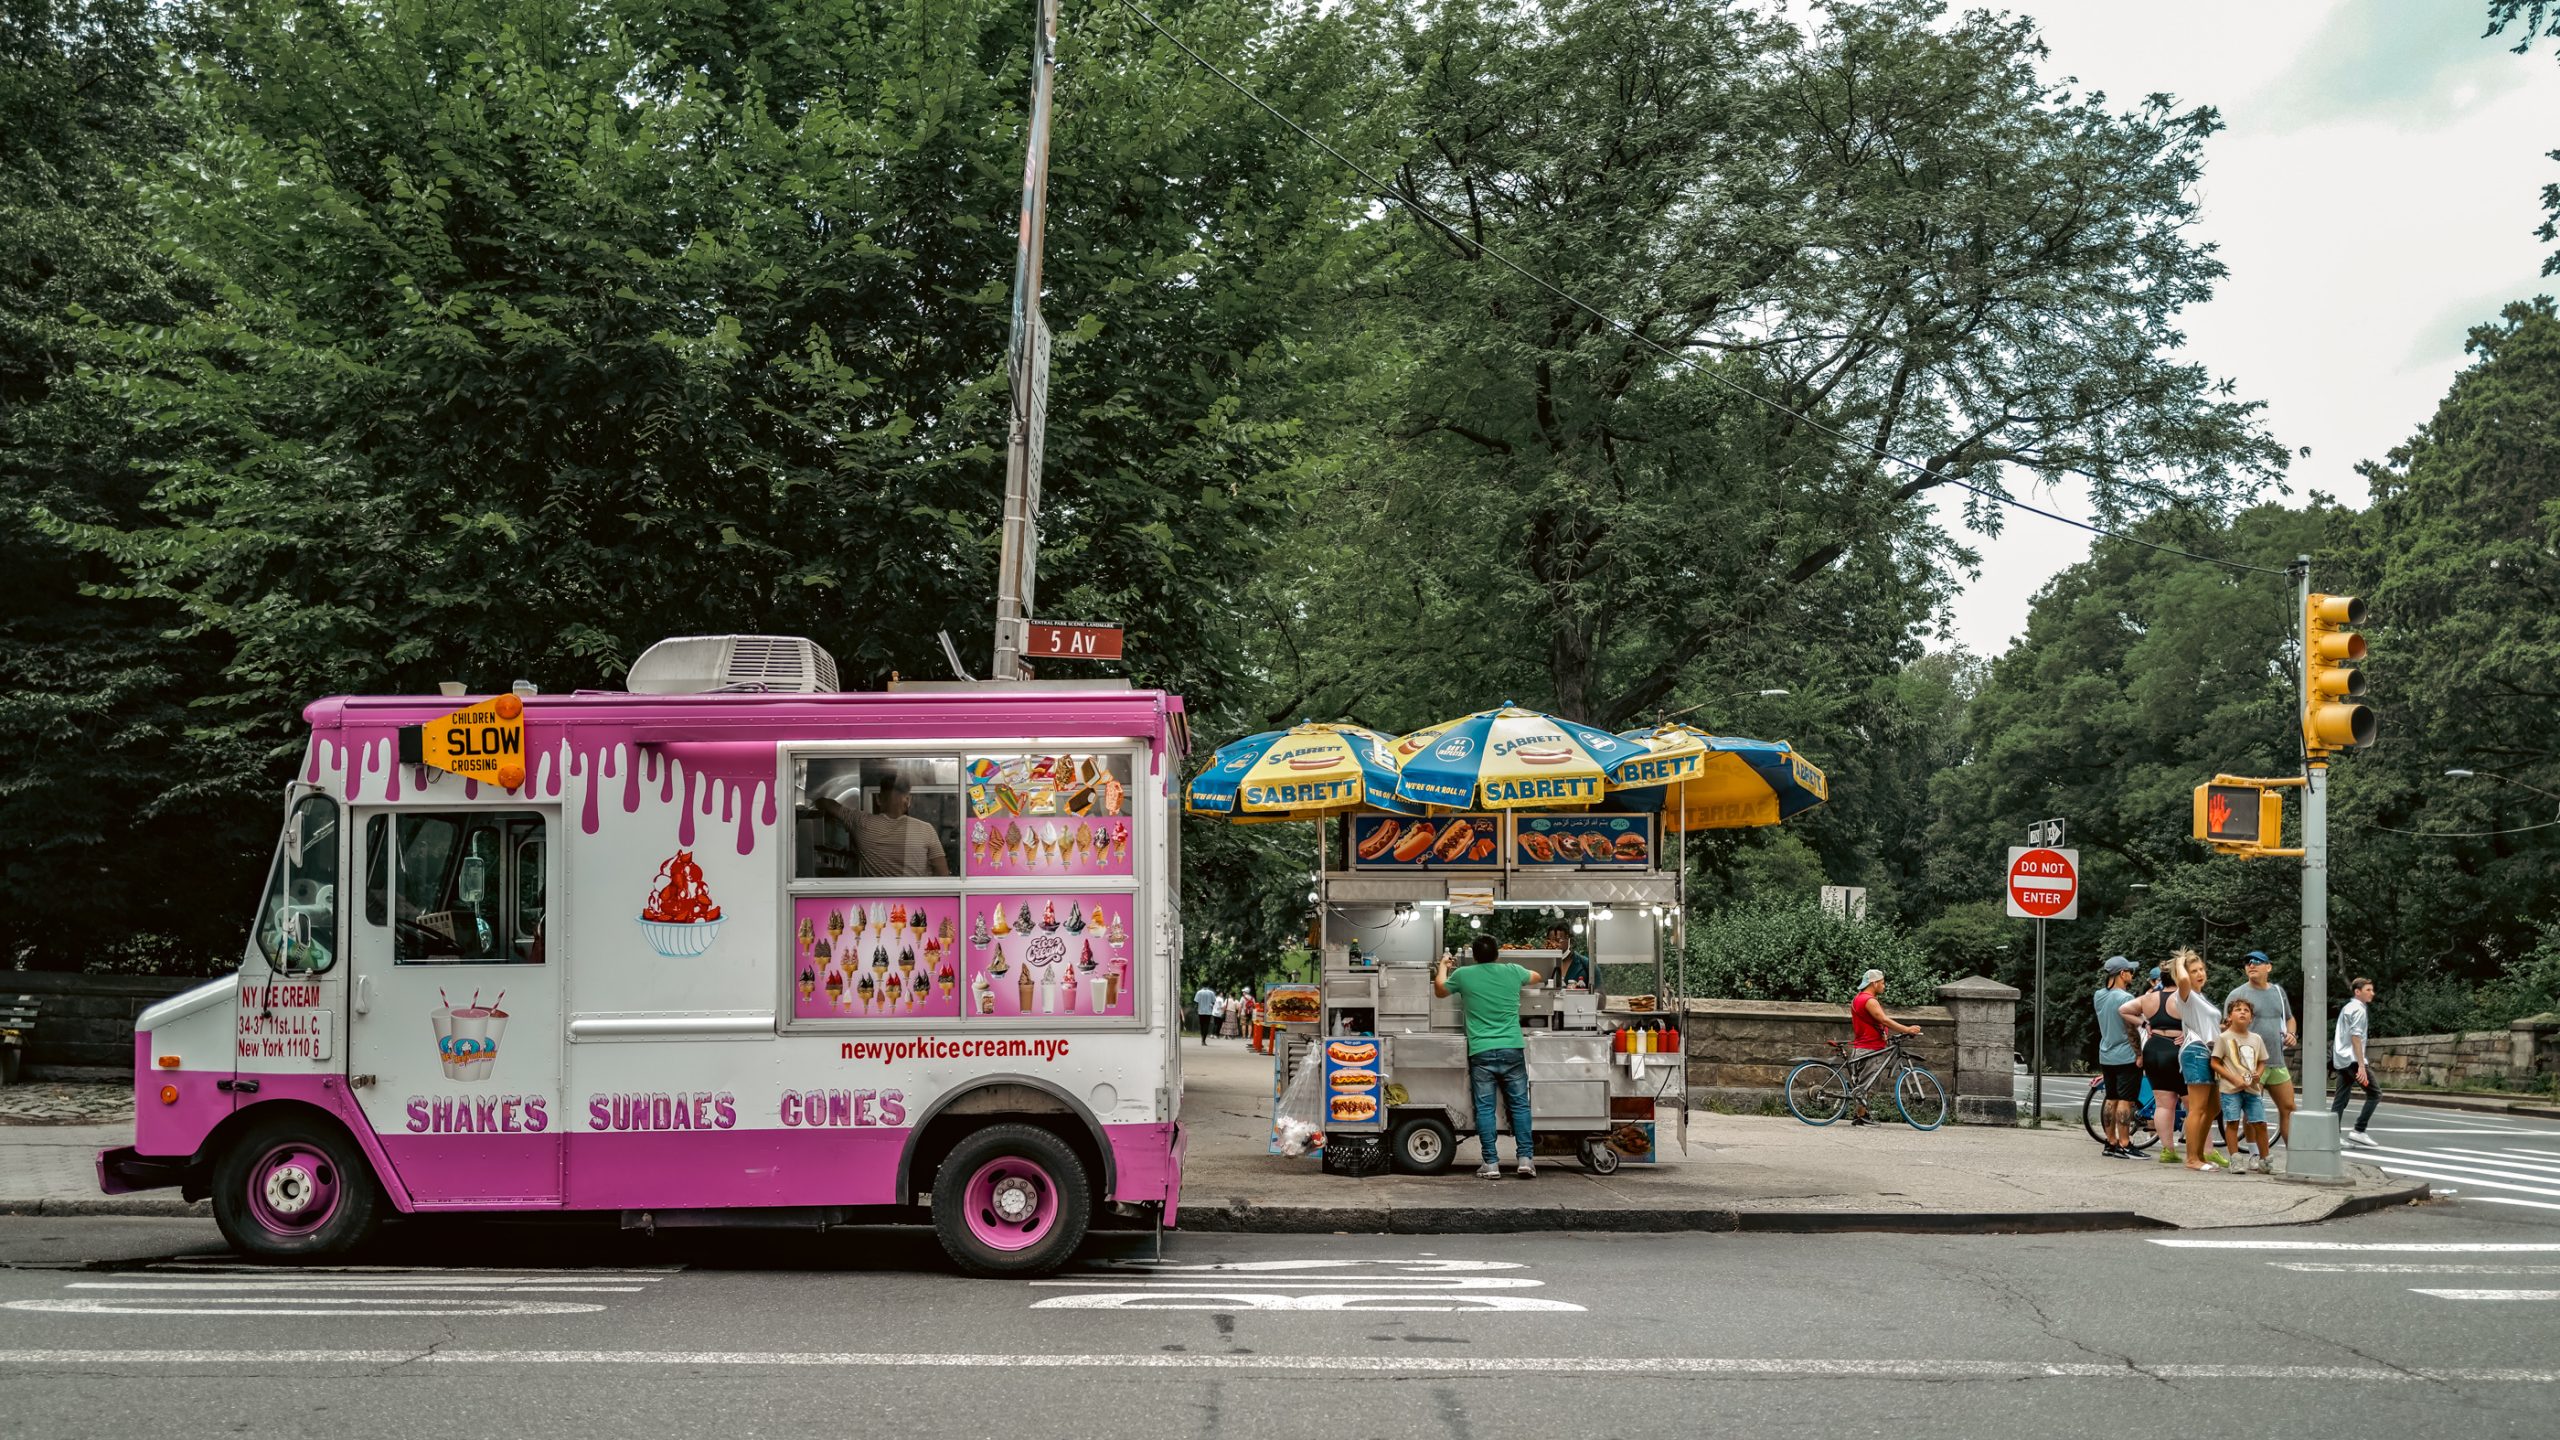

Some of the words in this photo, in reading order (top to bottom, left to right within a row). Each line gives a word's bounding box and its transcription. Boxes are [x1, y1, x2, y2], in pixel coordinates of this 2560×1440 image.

[1050, 630, 1061, 652] 5
[1070, 631, 1096, 654] Av
[452, 712, 496, 724] CHILDREN
[447, 727, 520, 756] SLOW
[1493, 735, 1561, 757] SABRETT
[451, 759, 498, 772] CROSSING
[1268, 745, 1342, 766] SABRETT
[1620, 754, 1700, 783] BRETT
[1247, 778, 1357, 805] SABRETT
[1425, 784, 1435, 792] ON
[1435, 785, 1441, 793] A
[1441, 786, 1457, 795] ROLL
[1486, 777, 1598, 802] SABRETT
[2021, 861, 2037, 873] DO
[2041, 862, 2065, 874] NOT
[2023, 891, 2061, 904] ENTER
[242, 986, 258, 1008] NY
[282, 986, 320, 1008] CREAM
[239, 1015, 265, 1035] 34-37
[238, 1038, 260, 1057] New
[262, 1038, 284, 1057] York
[841, 1036, 1069, 1065] newyorkicecream.nyc
[405, 1094, 549, 1133] SHAKES
[588, 1092, 737, 1130] SUNDAES
[780, 1088, 906, 1127] CONES
